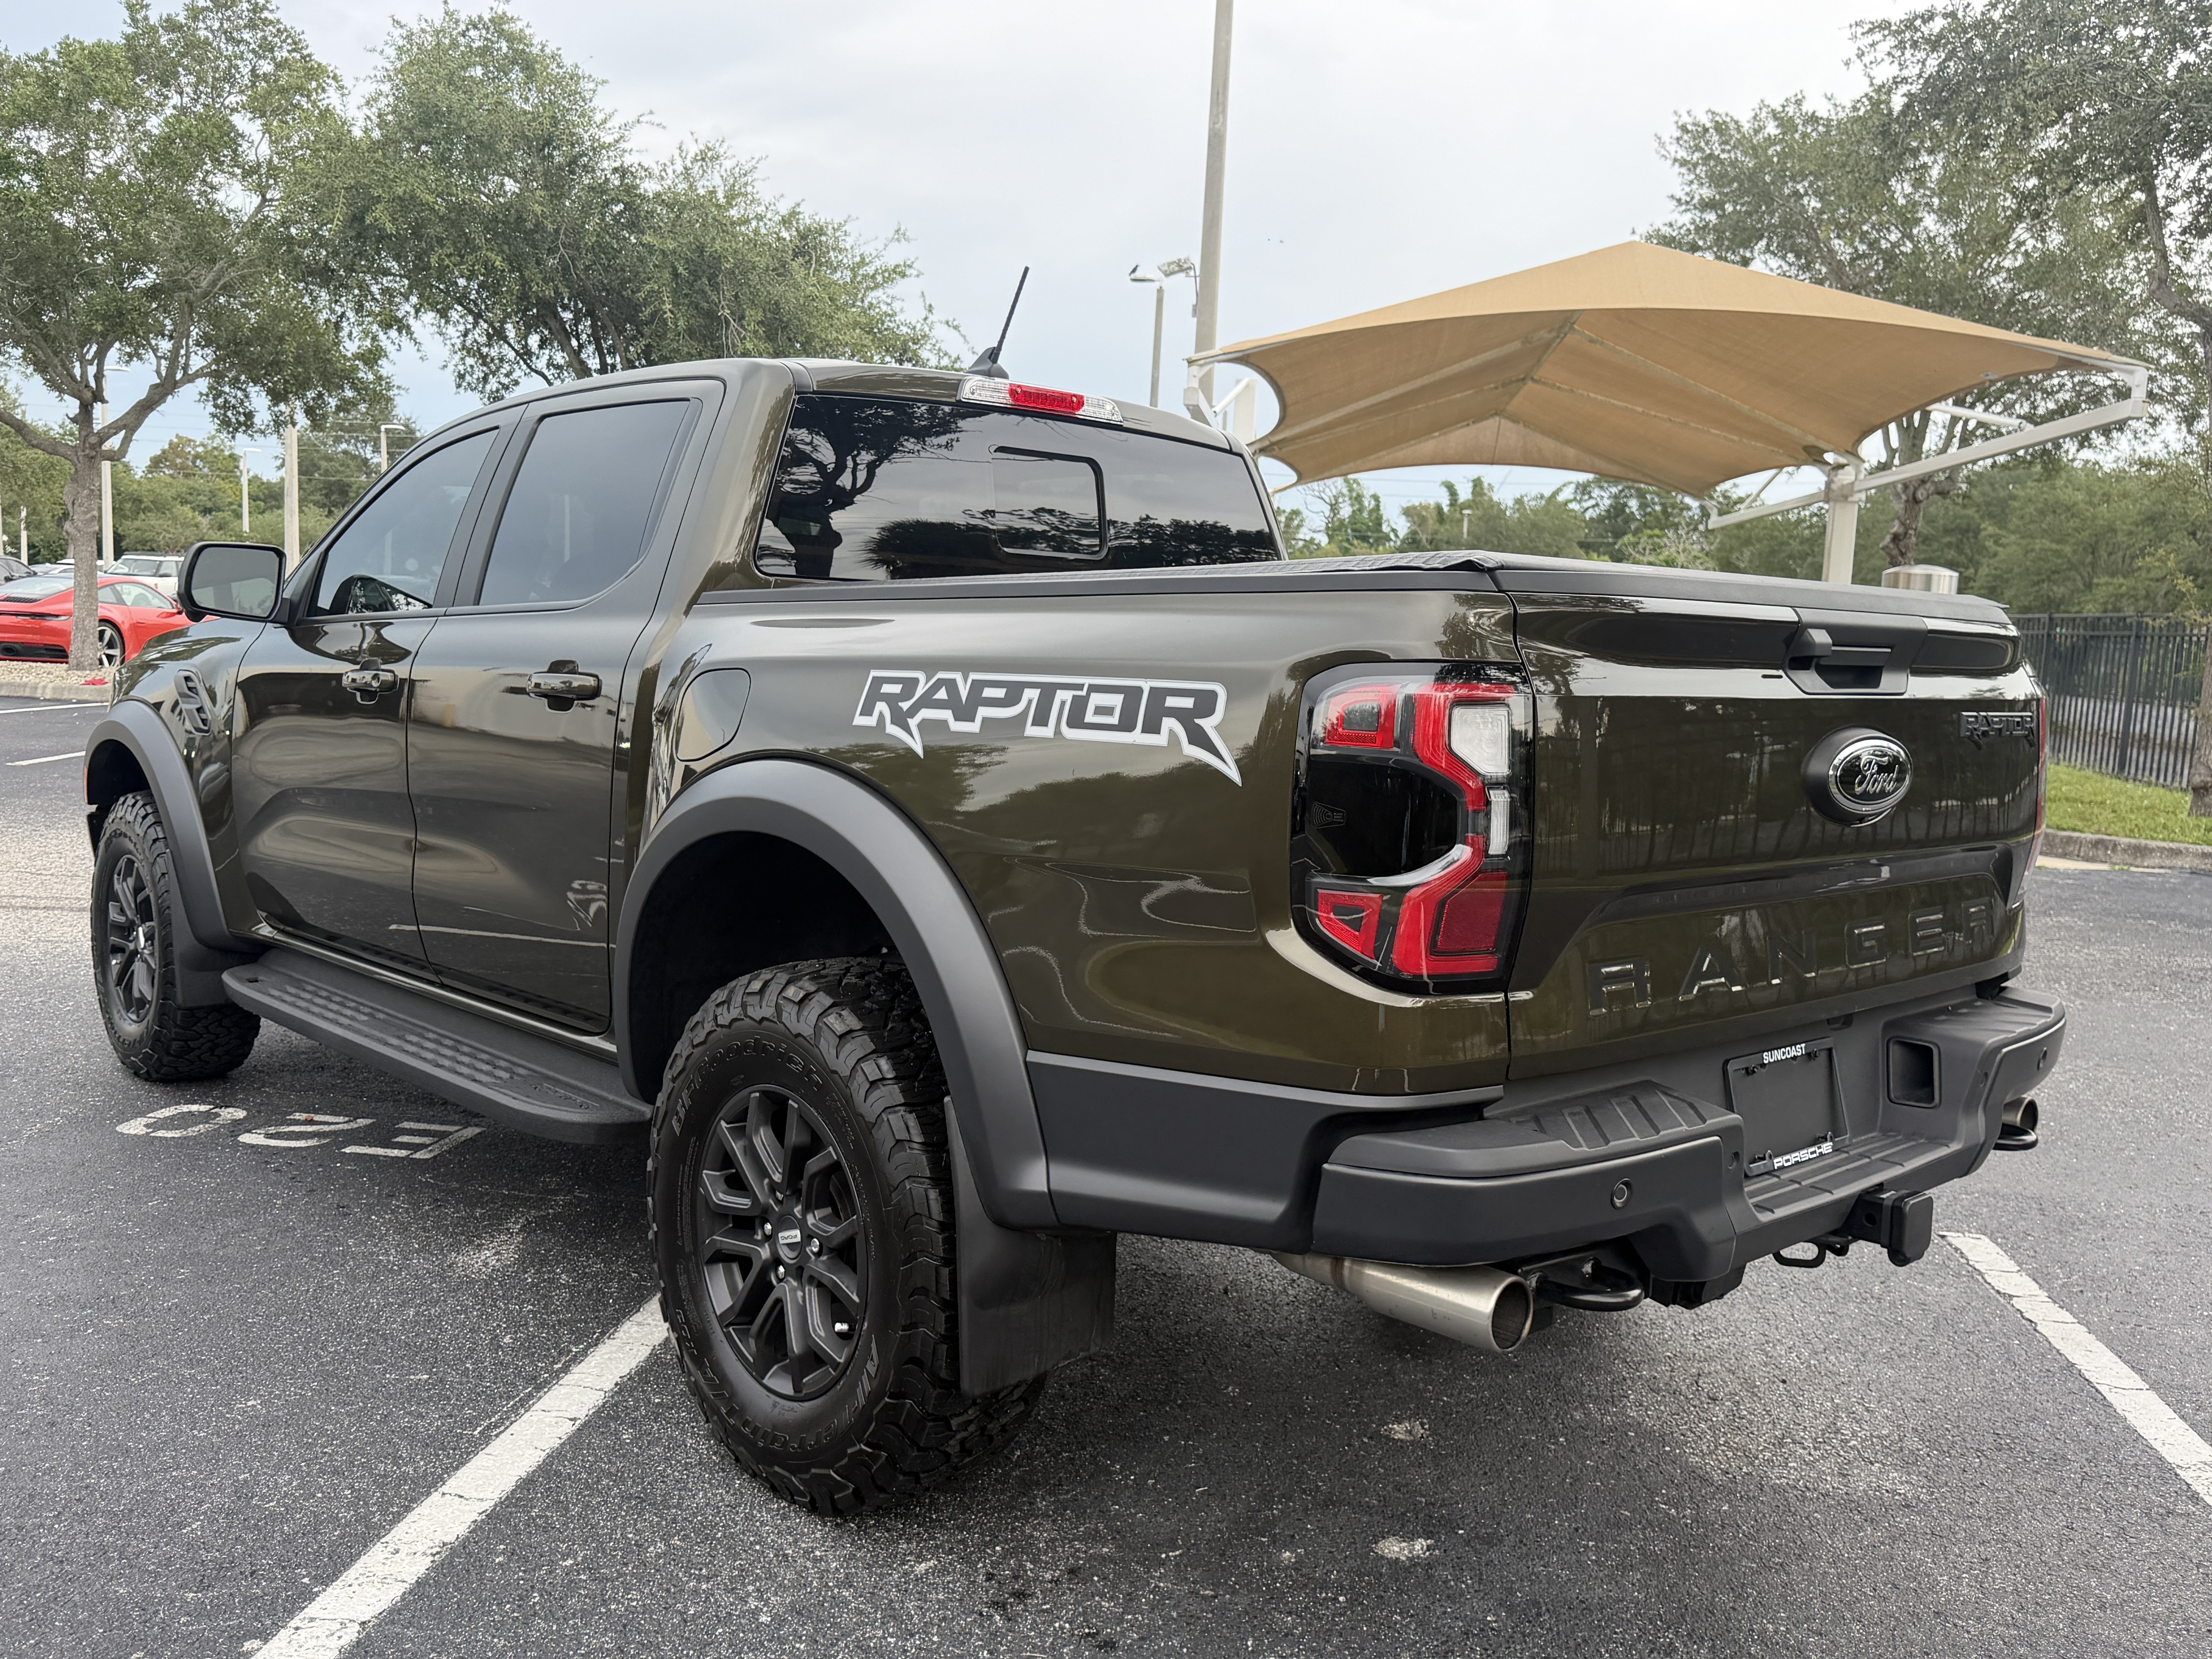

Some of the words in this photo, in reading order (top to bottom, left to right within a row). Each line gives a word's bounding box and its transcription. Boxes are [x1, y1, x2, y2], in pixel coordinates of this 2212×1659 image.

[852, 670, 1242, 787] RAPTOR
[1960, 711, 2036, 750] RAPTOR
[1855, 755, 1899, 795] Ford
[1587, 900, 1994, 1016] RANGER
[1763, 1043, 1805, 1063] SUNCOAST
[672, 1035, 823, 1137] BFGoodrich
[1773, 1142, 1833, 1170] PORSCHE
